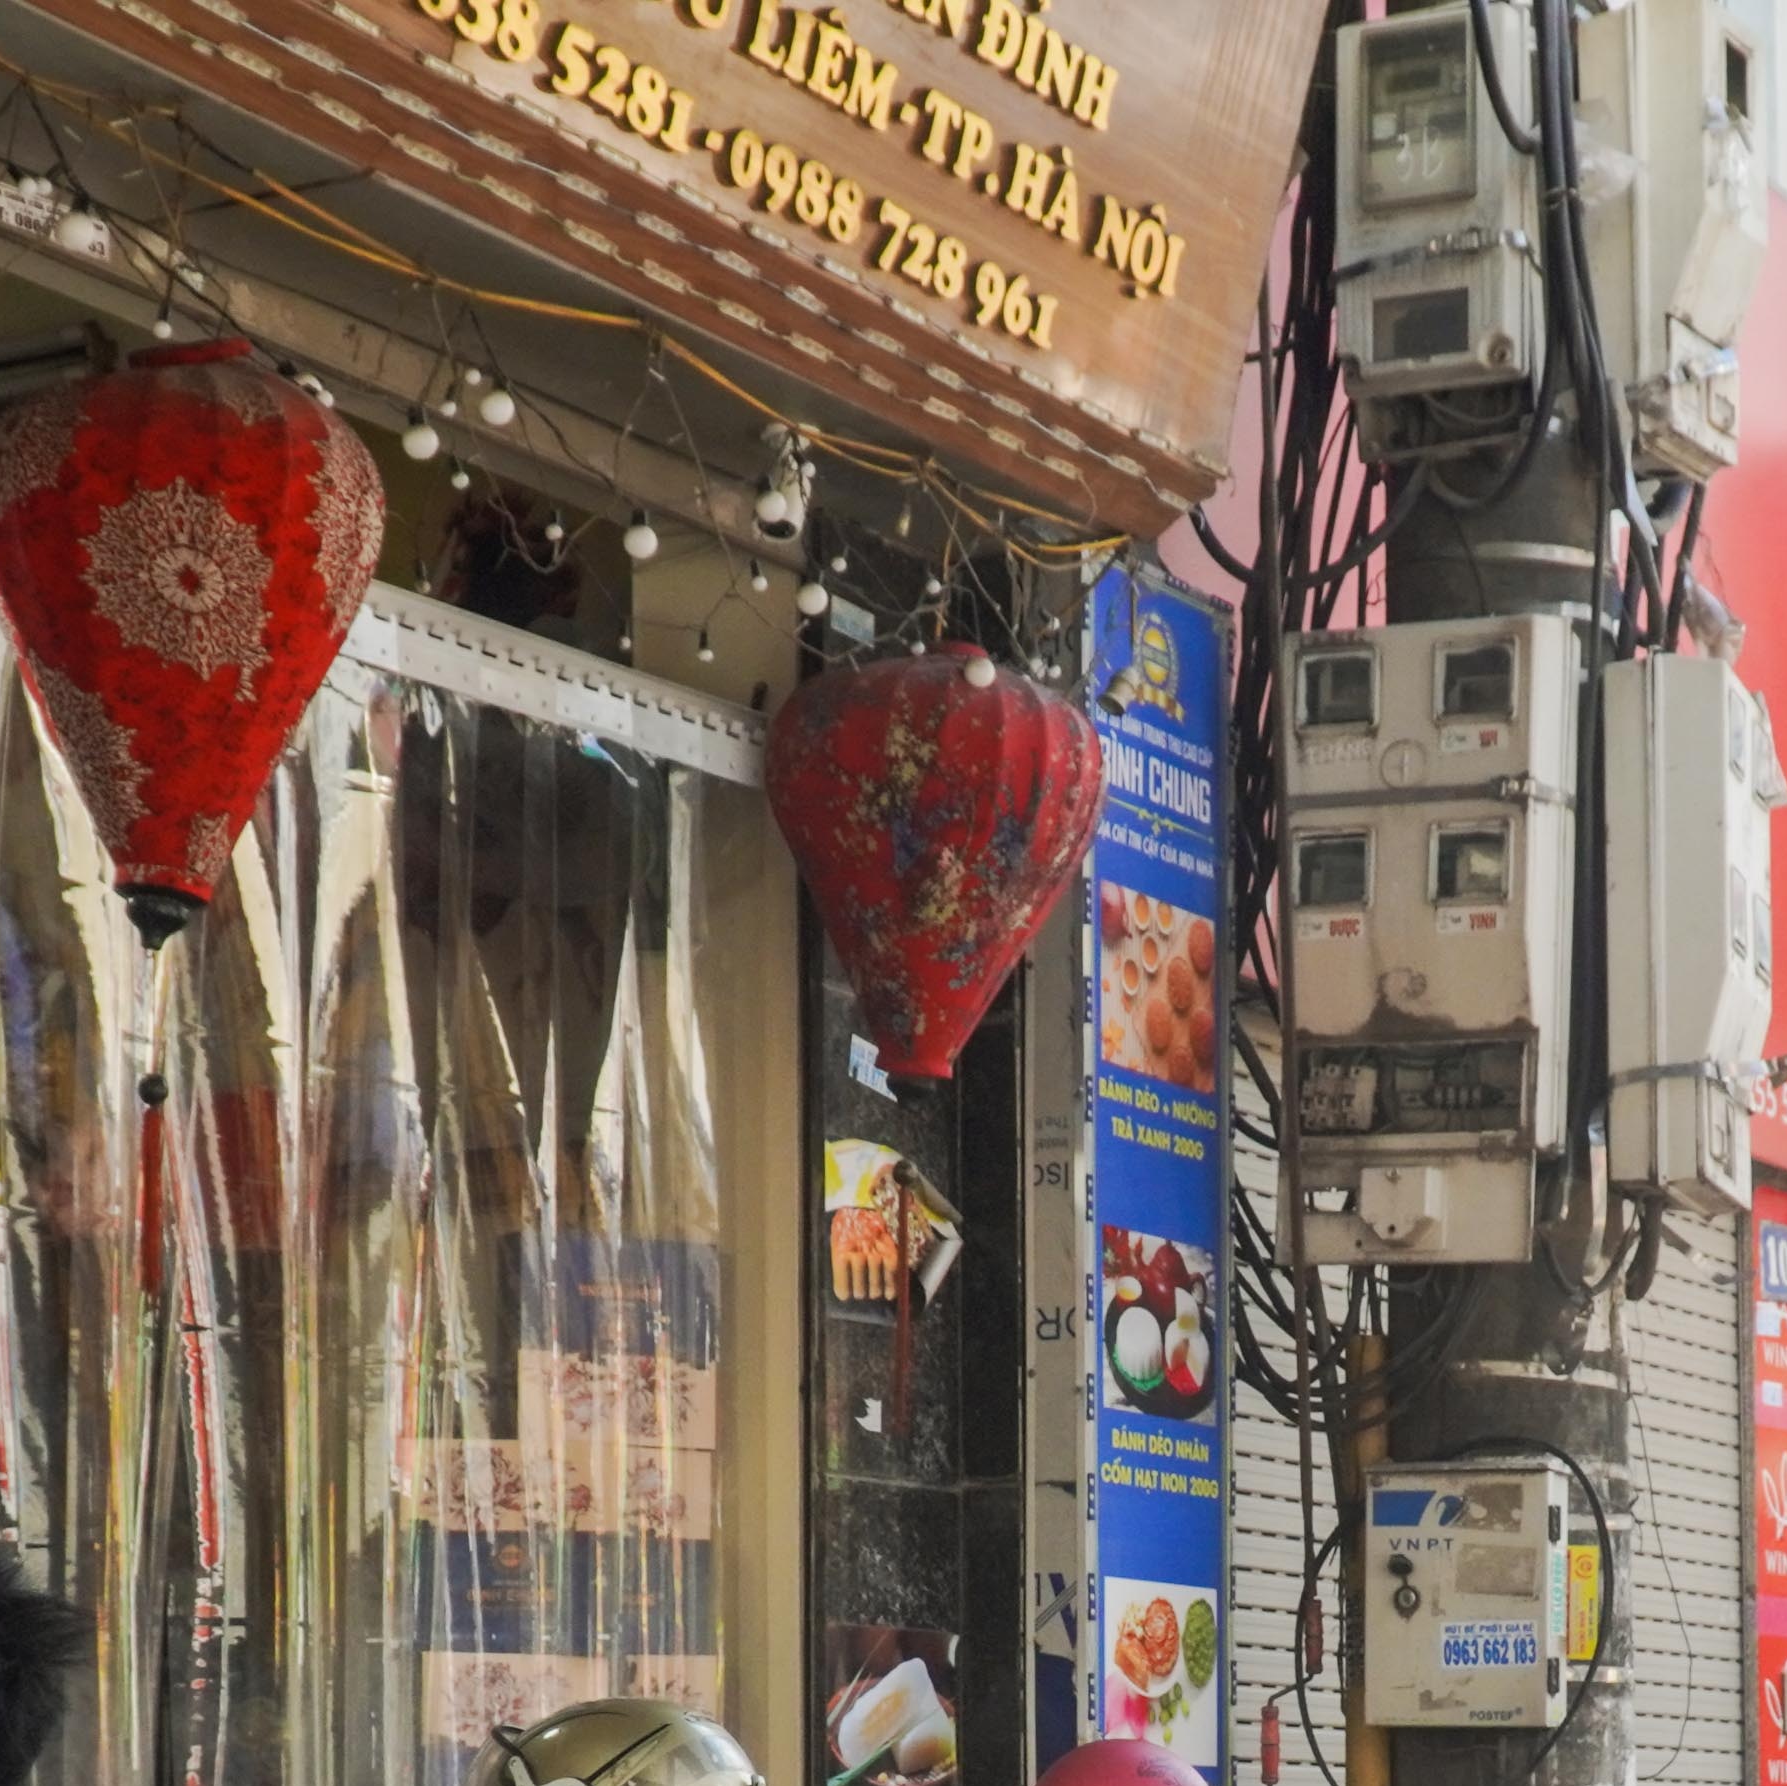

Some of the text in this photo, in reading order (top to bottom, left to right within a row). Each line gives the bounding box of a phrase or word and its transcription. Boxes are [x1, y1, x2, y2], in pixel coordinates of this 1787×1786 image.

[551, 22, 695, 155] 5281
[730, 129, 864, 245] 0988
[878, 200, 969, 300] 728
[974, 260, 1059, 350] 961
[1094, 195, 1186, 300] NỘI
[1100, 731, 1212, 825] BÌNH CHUNG
[1098, 1075, 1133, 1106] BÁNH
[1111, 1116, 1134, 1141] TRÀ
[1137, 1123, 1171, 1151] XANH
[1112, 1424, 1146, 1452] BÁNH
[1101, 1457, 1132, 1486] CỐM
[1134, 1467, 1158, 1495] HẠT
[1161, 1472, 1187, 1494] NON
[1389, 1537, 1455, 1551] VNPT
[1444, 1638, 1537, 1666] 0963 662 183
